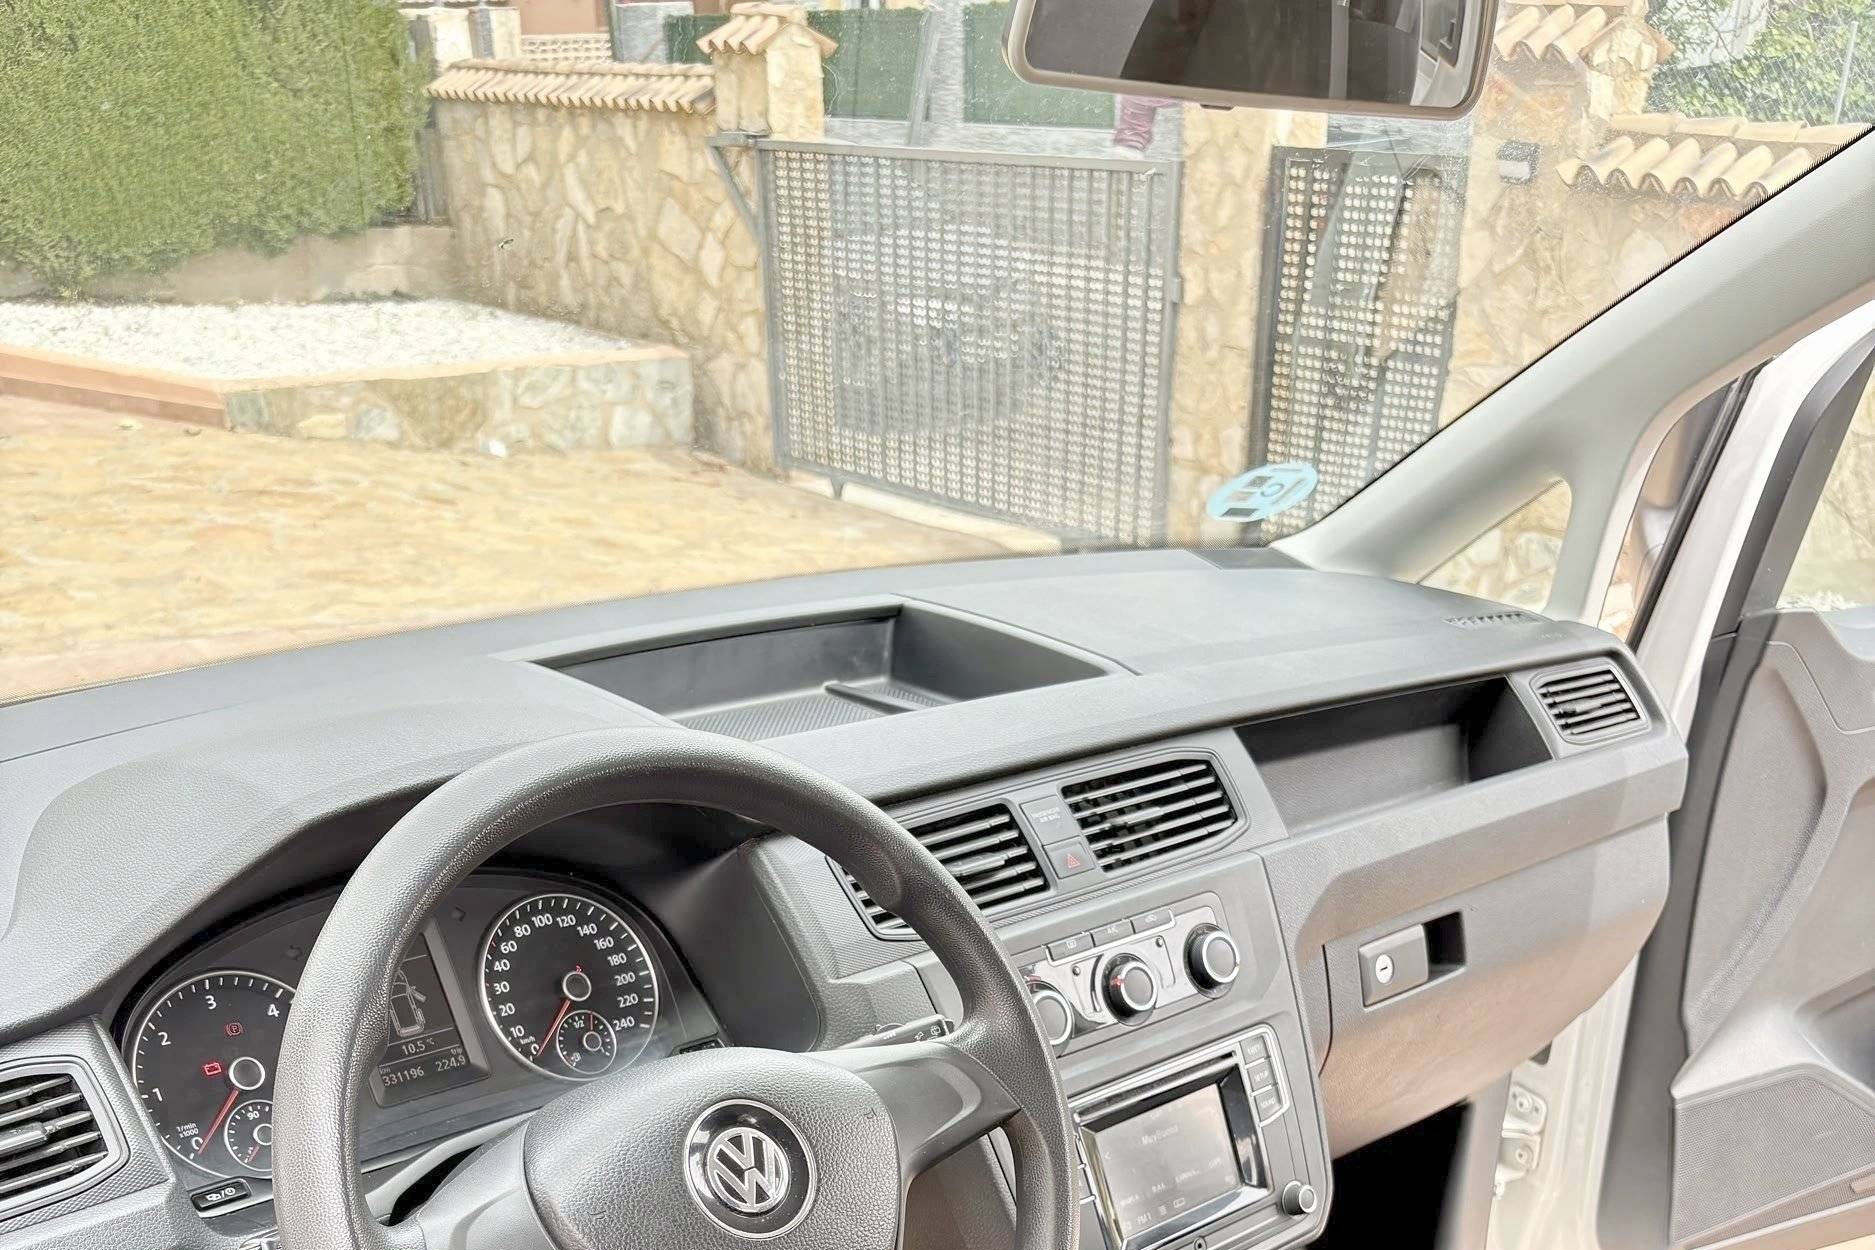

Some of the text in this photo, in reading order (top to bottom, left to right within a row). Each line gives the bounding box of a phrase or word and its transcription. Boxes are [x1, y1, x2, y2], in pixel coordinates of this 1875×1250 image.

[532, 913, 553, 928] 100
[556, 914, 577, 928] 120
[513, 924, 531, 938] 80
[577, 923, 598, 937] 140
[500, 940, 518, 954] 60
[594, 936, 615, 950] 160
[493, 959, 511, 972] 40
[607, 952, 627, 967] 180
[614, 972, 636, 986] 200
[493, 981, 510, 995] 30
[205, 995, 217, 1010] 3
[617, 993, 639, 1008] 220
[267, 1003, 280, 1018] 4
[499, 1003, 516, 1016] 20
[613, 1016, 635, 1031] 240
[158, 1031, 171, 1046] 2
[510, 1025, 525, 1038] 10
[402, 1040, 426, 1055] 10.5
[530, 1043, 539, 1055] 0
[382, 1055, 466, 1086] 331196 224.9
[152, 1087, 163, 1102] 1
[247, 1110, 260, 1121] 90
[176, 1121, 197, 1132] 1/min
[179, 1128, 199, 1138] x1000
[192, 1136, 204, 1150] 0
